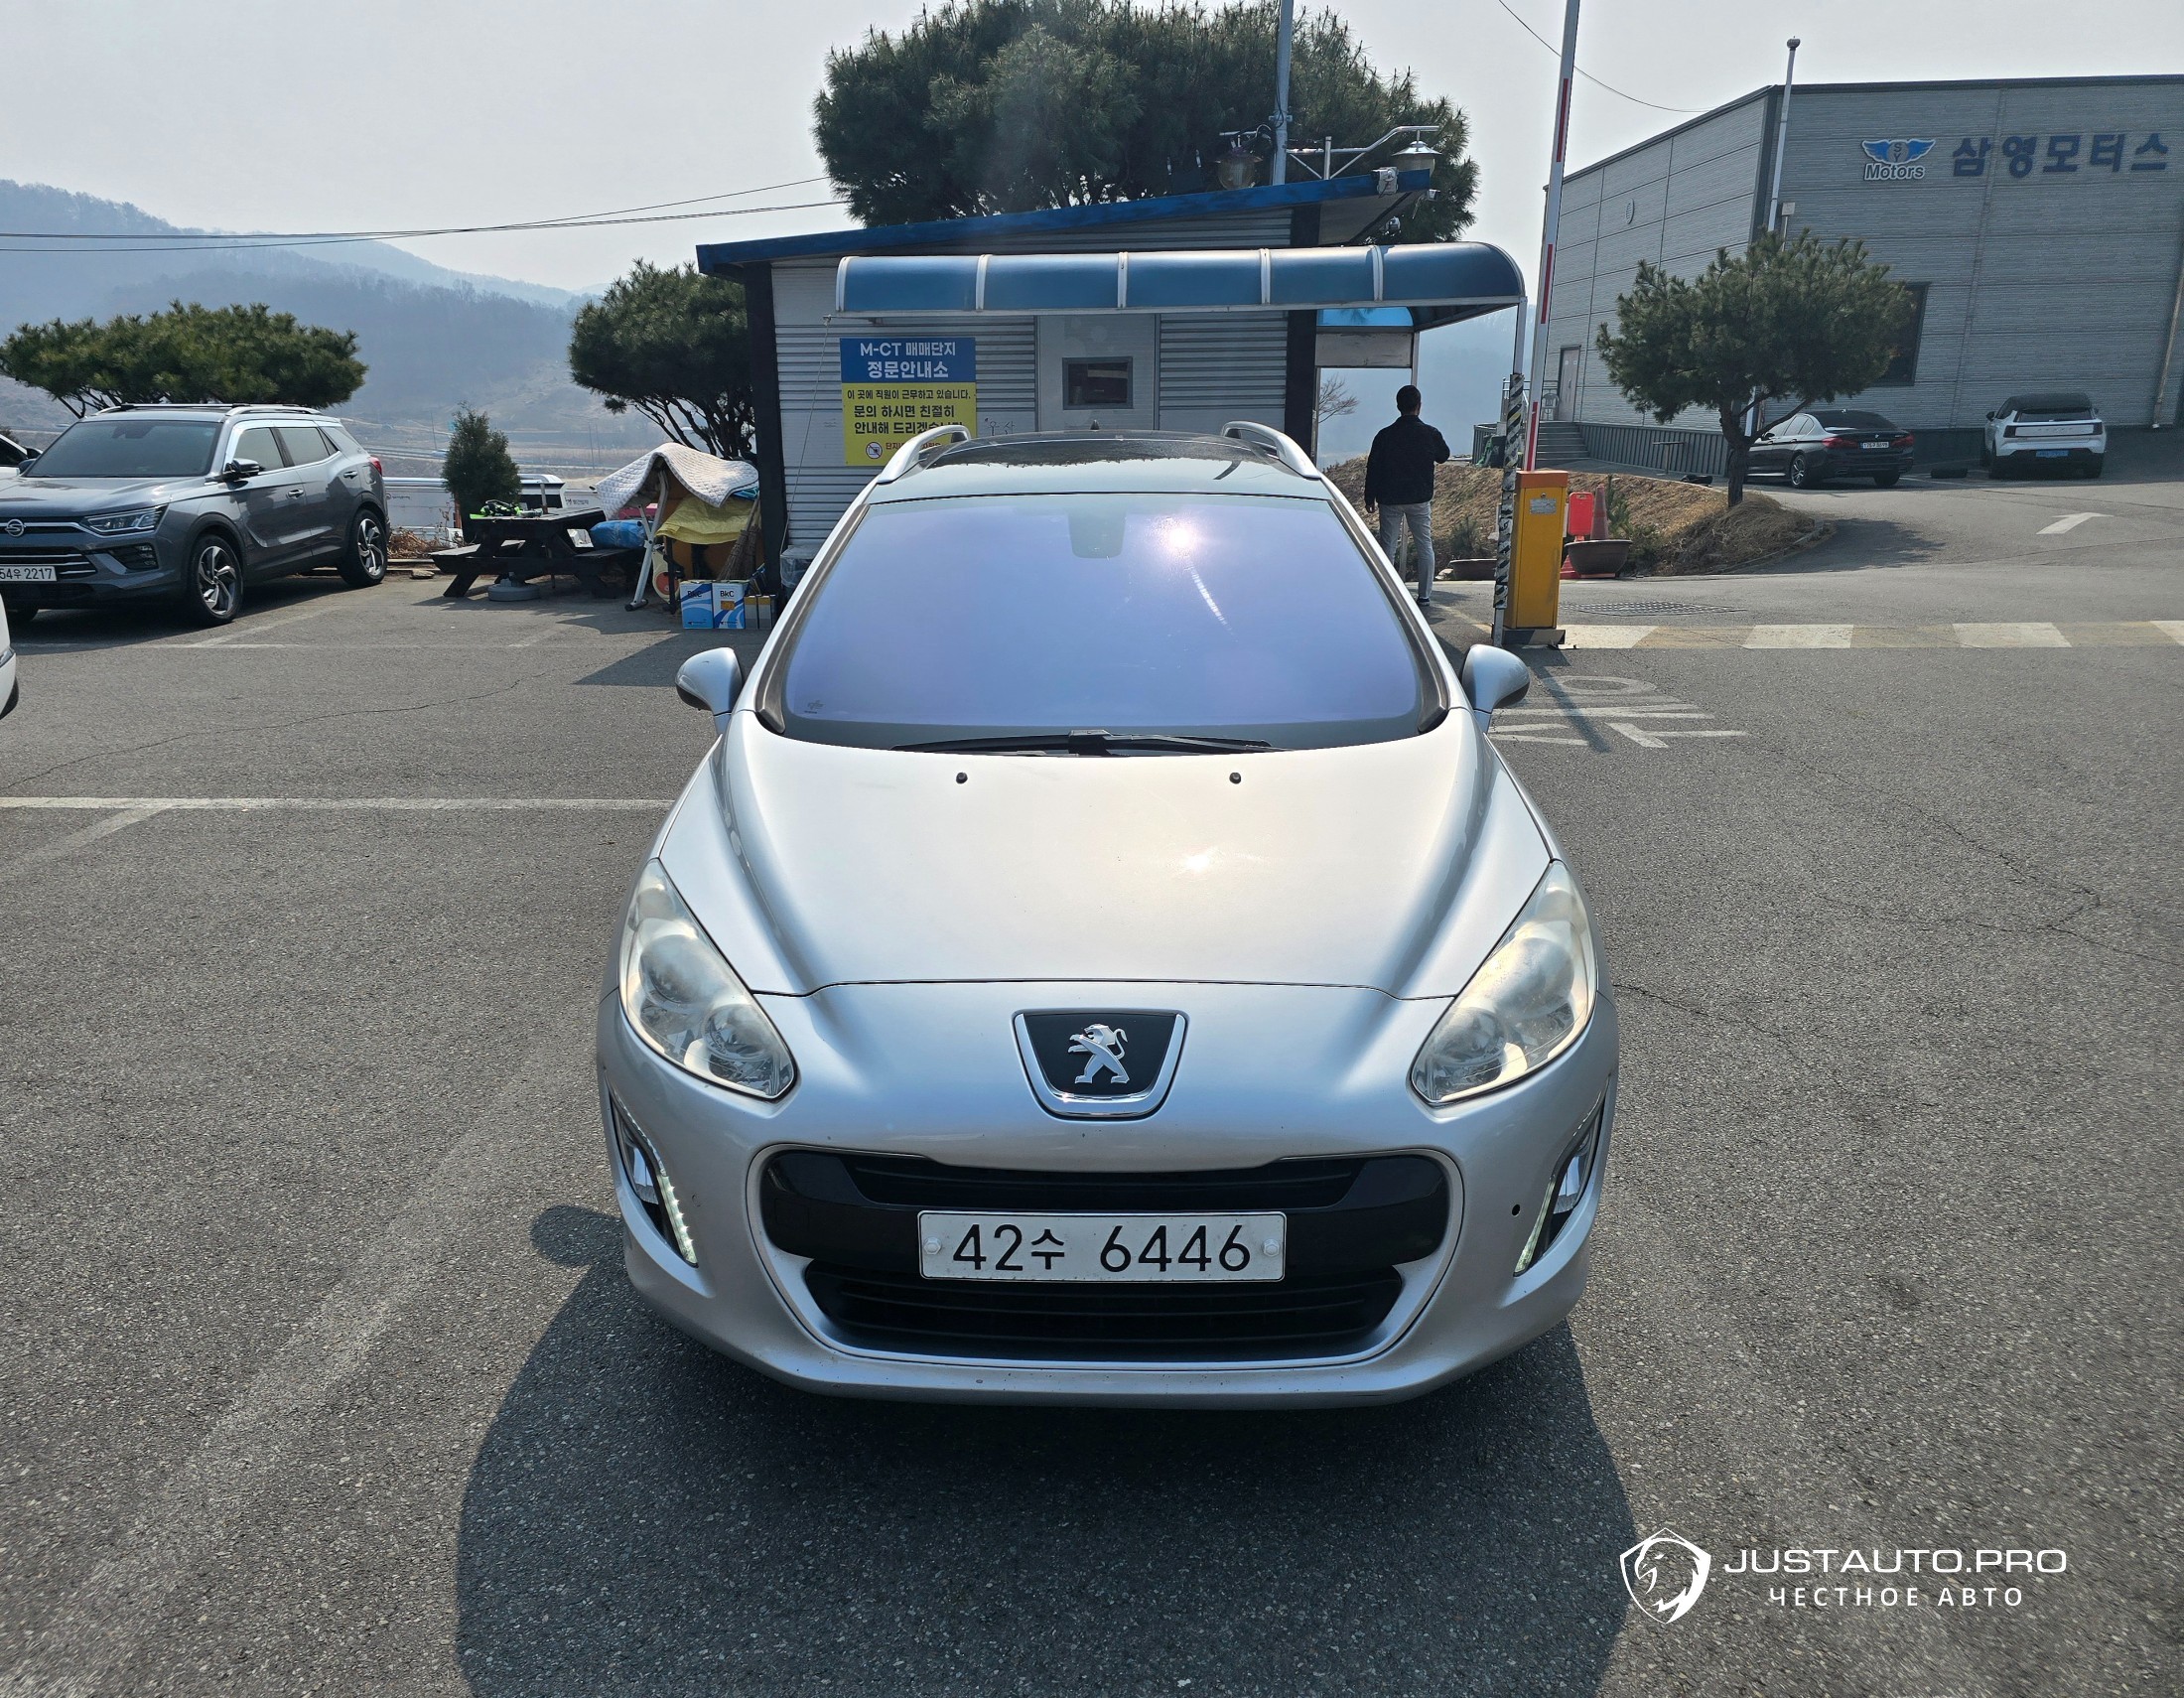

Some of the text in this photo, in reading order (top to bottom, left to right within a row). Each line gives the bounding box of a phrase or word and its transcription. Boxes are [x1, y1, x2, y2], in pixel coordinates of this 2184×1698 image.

[1952, 132, 2169, 179] 삼영모터스
[1864, 163, 1926, 180] Motors
[860, 342, 956, 356] M-CT 매매단지
[868, 360, 949, 379] 정문안내소
[847, 389, 971, 400] 이 곳에 직원이 근무하고 있습니다.
[854, 405, 955, 418] 문의 하시면 친절히
[854, 422, 889, 435] 안내해
[24, 568, 53, 580] 2217
[952, 1223, 1252, 1273] 42수 6446
